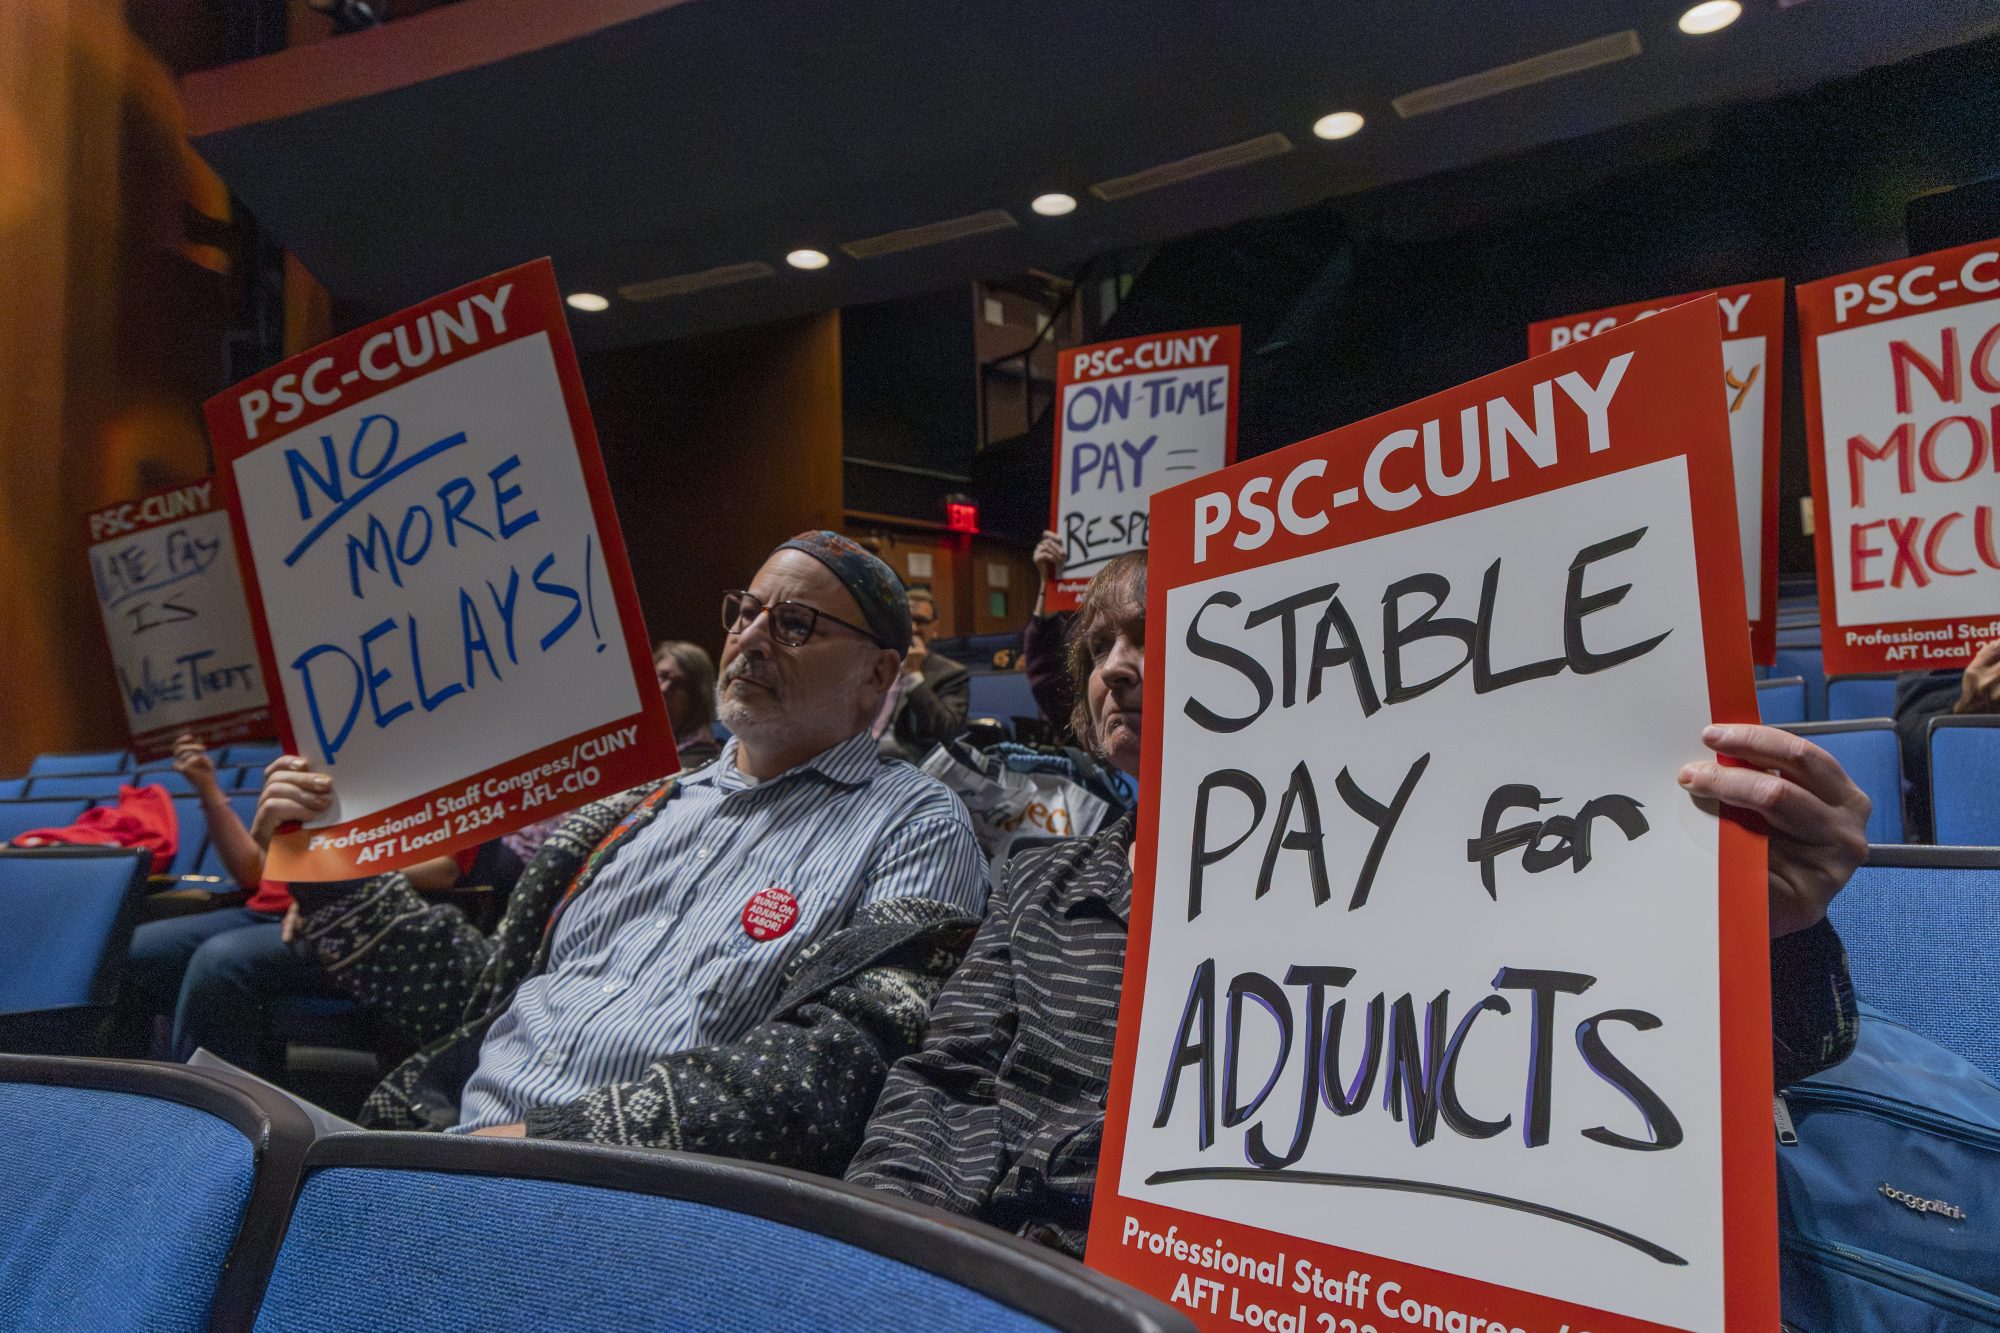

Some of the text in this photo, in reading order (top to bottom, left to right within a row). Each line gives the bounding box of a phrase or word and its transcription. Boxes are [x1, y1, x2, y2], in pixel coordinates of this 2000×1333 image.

[239, 283, 514, 440] PSC-CUNY
[1066, 376, 1225, 432] ON-TIME
[1074, 335, 1219, 379] PSC-CUNY
[285, 414, 398, 520] NO
[1070, 435, 1158, 496] PAY
[1193, 351, 1636, 564] PSC-CUNY
[89, 481, 214, 541] PSC-CUNY
[346, 455, 540, 599] MORE
[290, 534, 608, 765] DELAYS!
[1184, 526, 1675, 734] STABLE
[1845, 625, 1953, 646] Professional
[1885, 645, 1919, 661] AFT
[1922, 642, 1971, 659] Local
[308, 725, 640, 851] Professional Staff Congress/CUNY
[356, 838, 398, 866] AFT
[400, 822, 451, 854] Local
[454, 802, 505, 835] 2334
[521, 766, 602, 811] AFL-CIO
[1187, 751, 1431, 923] PAY
[749, 904, 790, 925] ADJUNCT
[753, 895, 795, 916] RUNS ON
[766, 890, 792, 904] CUNY
[1152, 958, 1684, 1171] ADJUNCTS
[1121, 1215, 1286, 1288] Professional
[1291, 1259, 1371, 1310] Staff
[1170, 1273, 1225, 1315] AFT
[1229, 1287, 1307, 1333] Local
